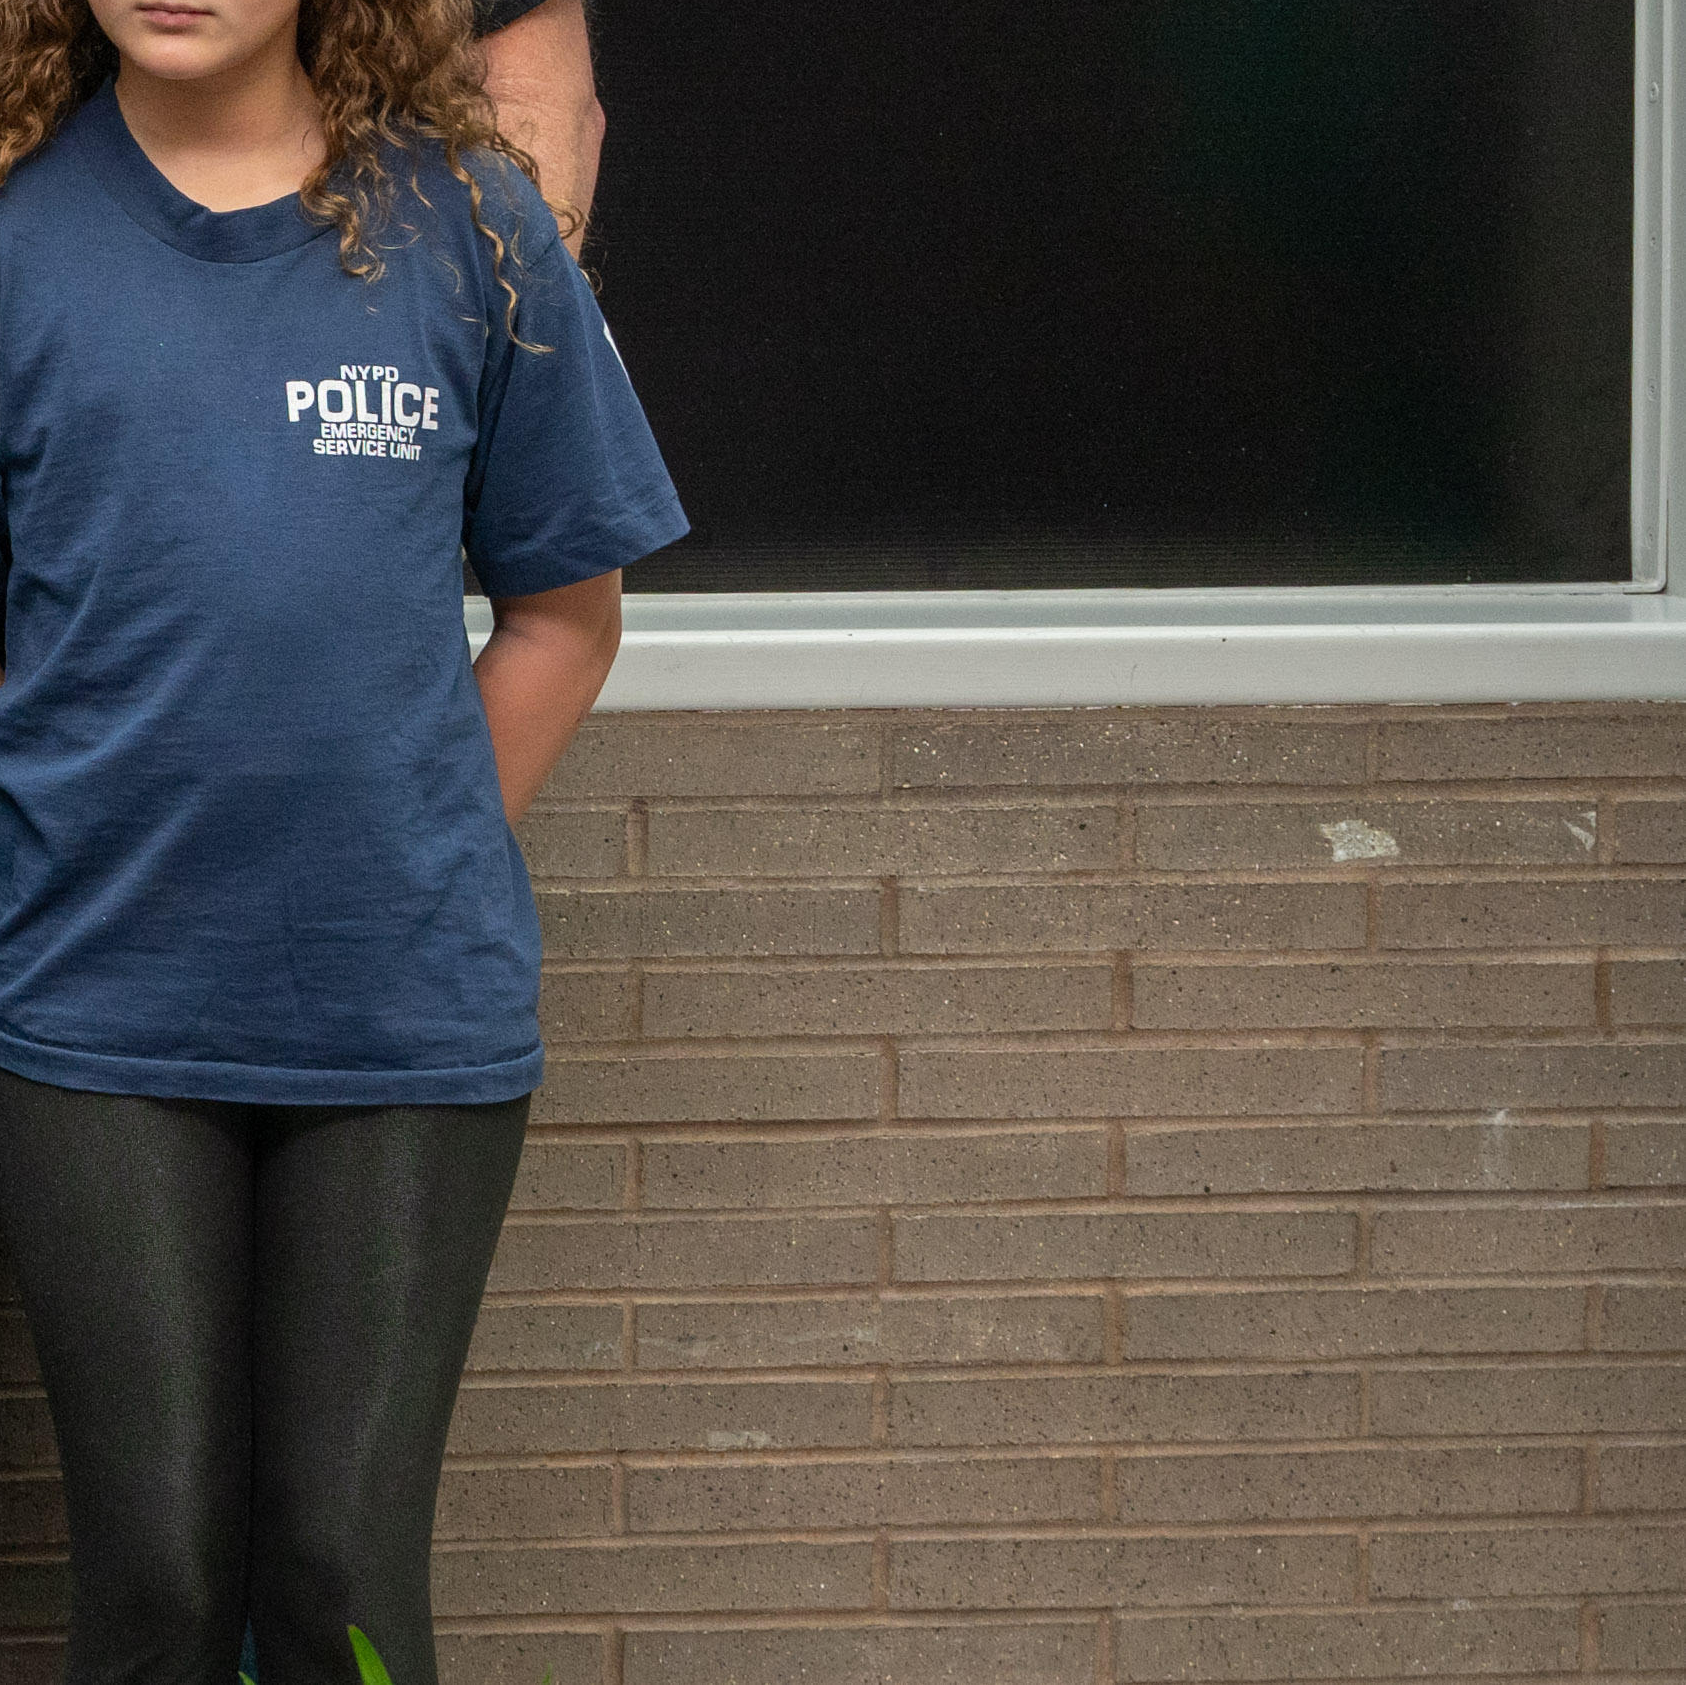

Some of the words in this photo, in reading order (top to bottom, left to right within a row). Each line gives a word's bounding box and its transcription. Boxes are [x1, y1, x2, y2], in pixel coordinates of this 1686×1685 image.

[339, 364, 399, 383] NYPD
[285, 379, 440, 431] POLICE
[320, 422, 417, 444] EMERGENCY
[313, 439, 387, 458] SERVICE
[389, 443, 422, 461] UNIT
